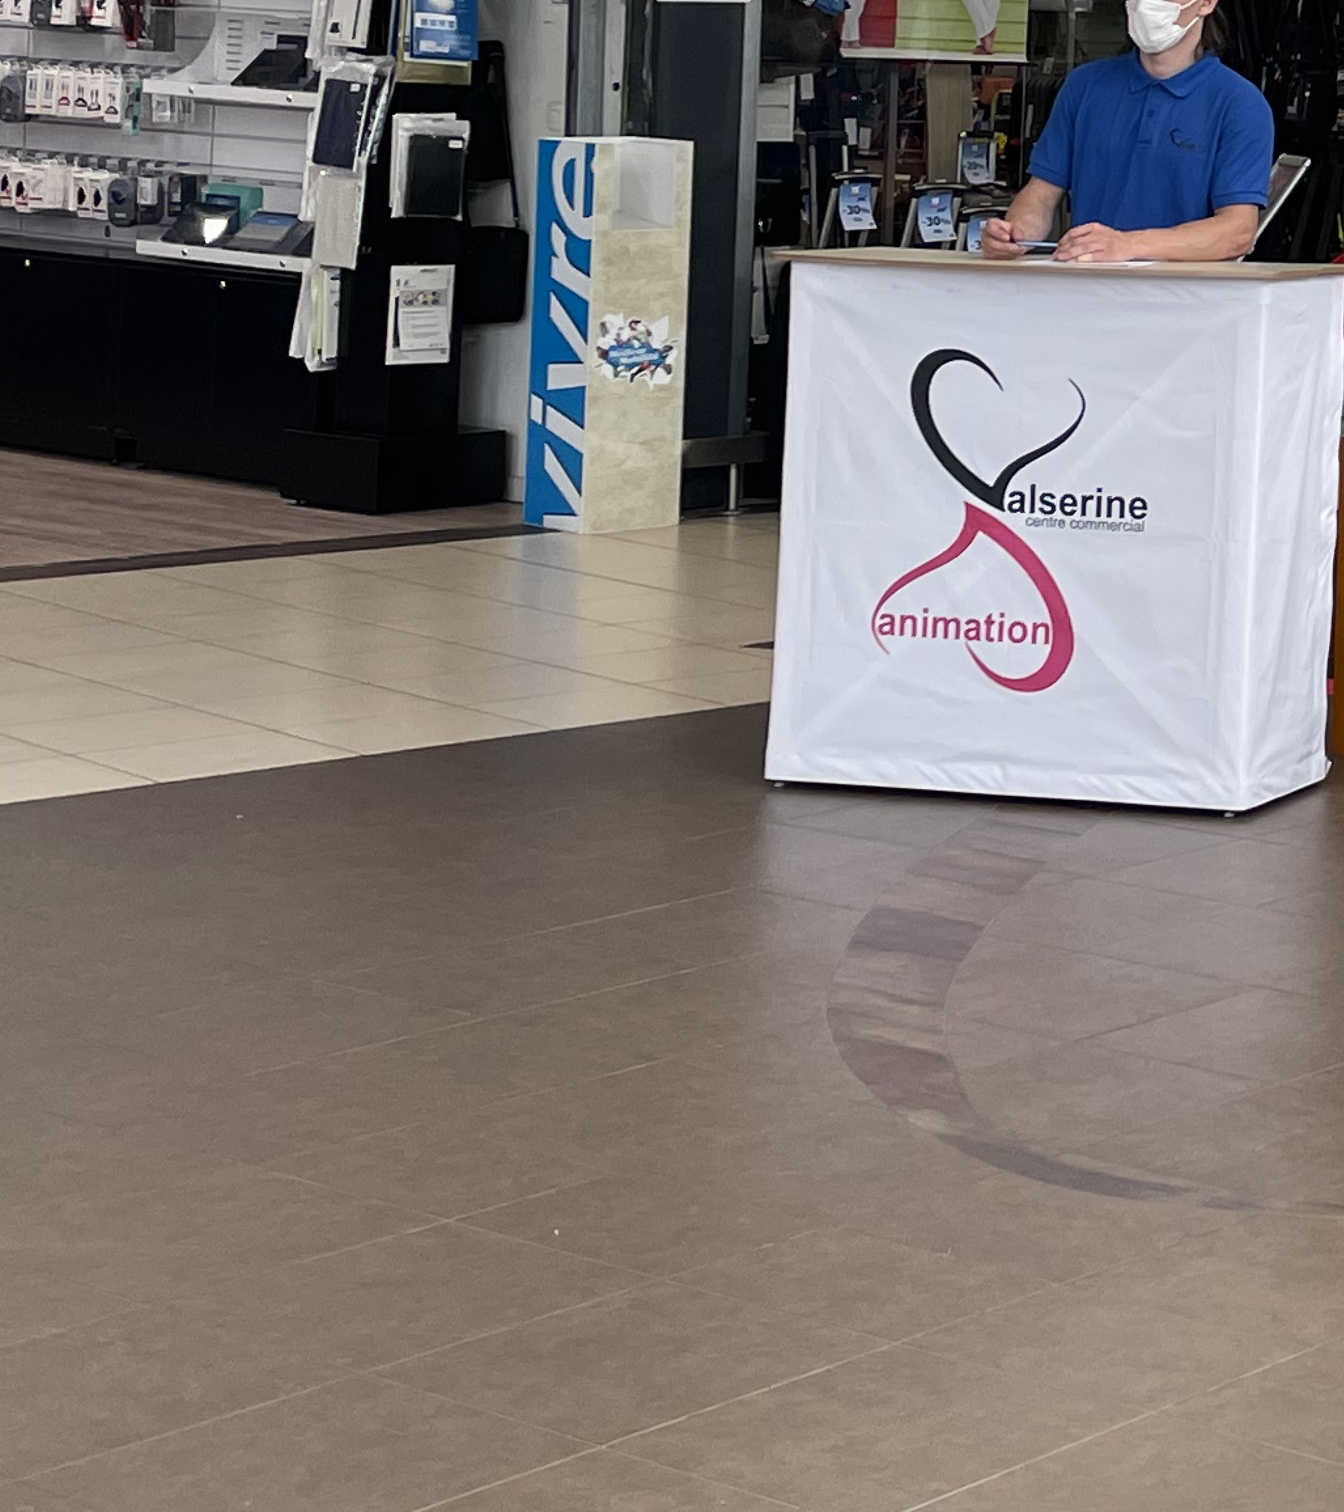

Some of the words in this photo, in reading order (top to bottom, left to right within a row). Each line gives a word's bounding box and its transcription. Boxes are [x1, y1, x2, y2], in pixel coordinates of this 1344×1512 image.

[1025, 516, 1066, 528] centre
[1069, 519, 1146, 532] commercial
[877, 607, 1050, 645] animation
